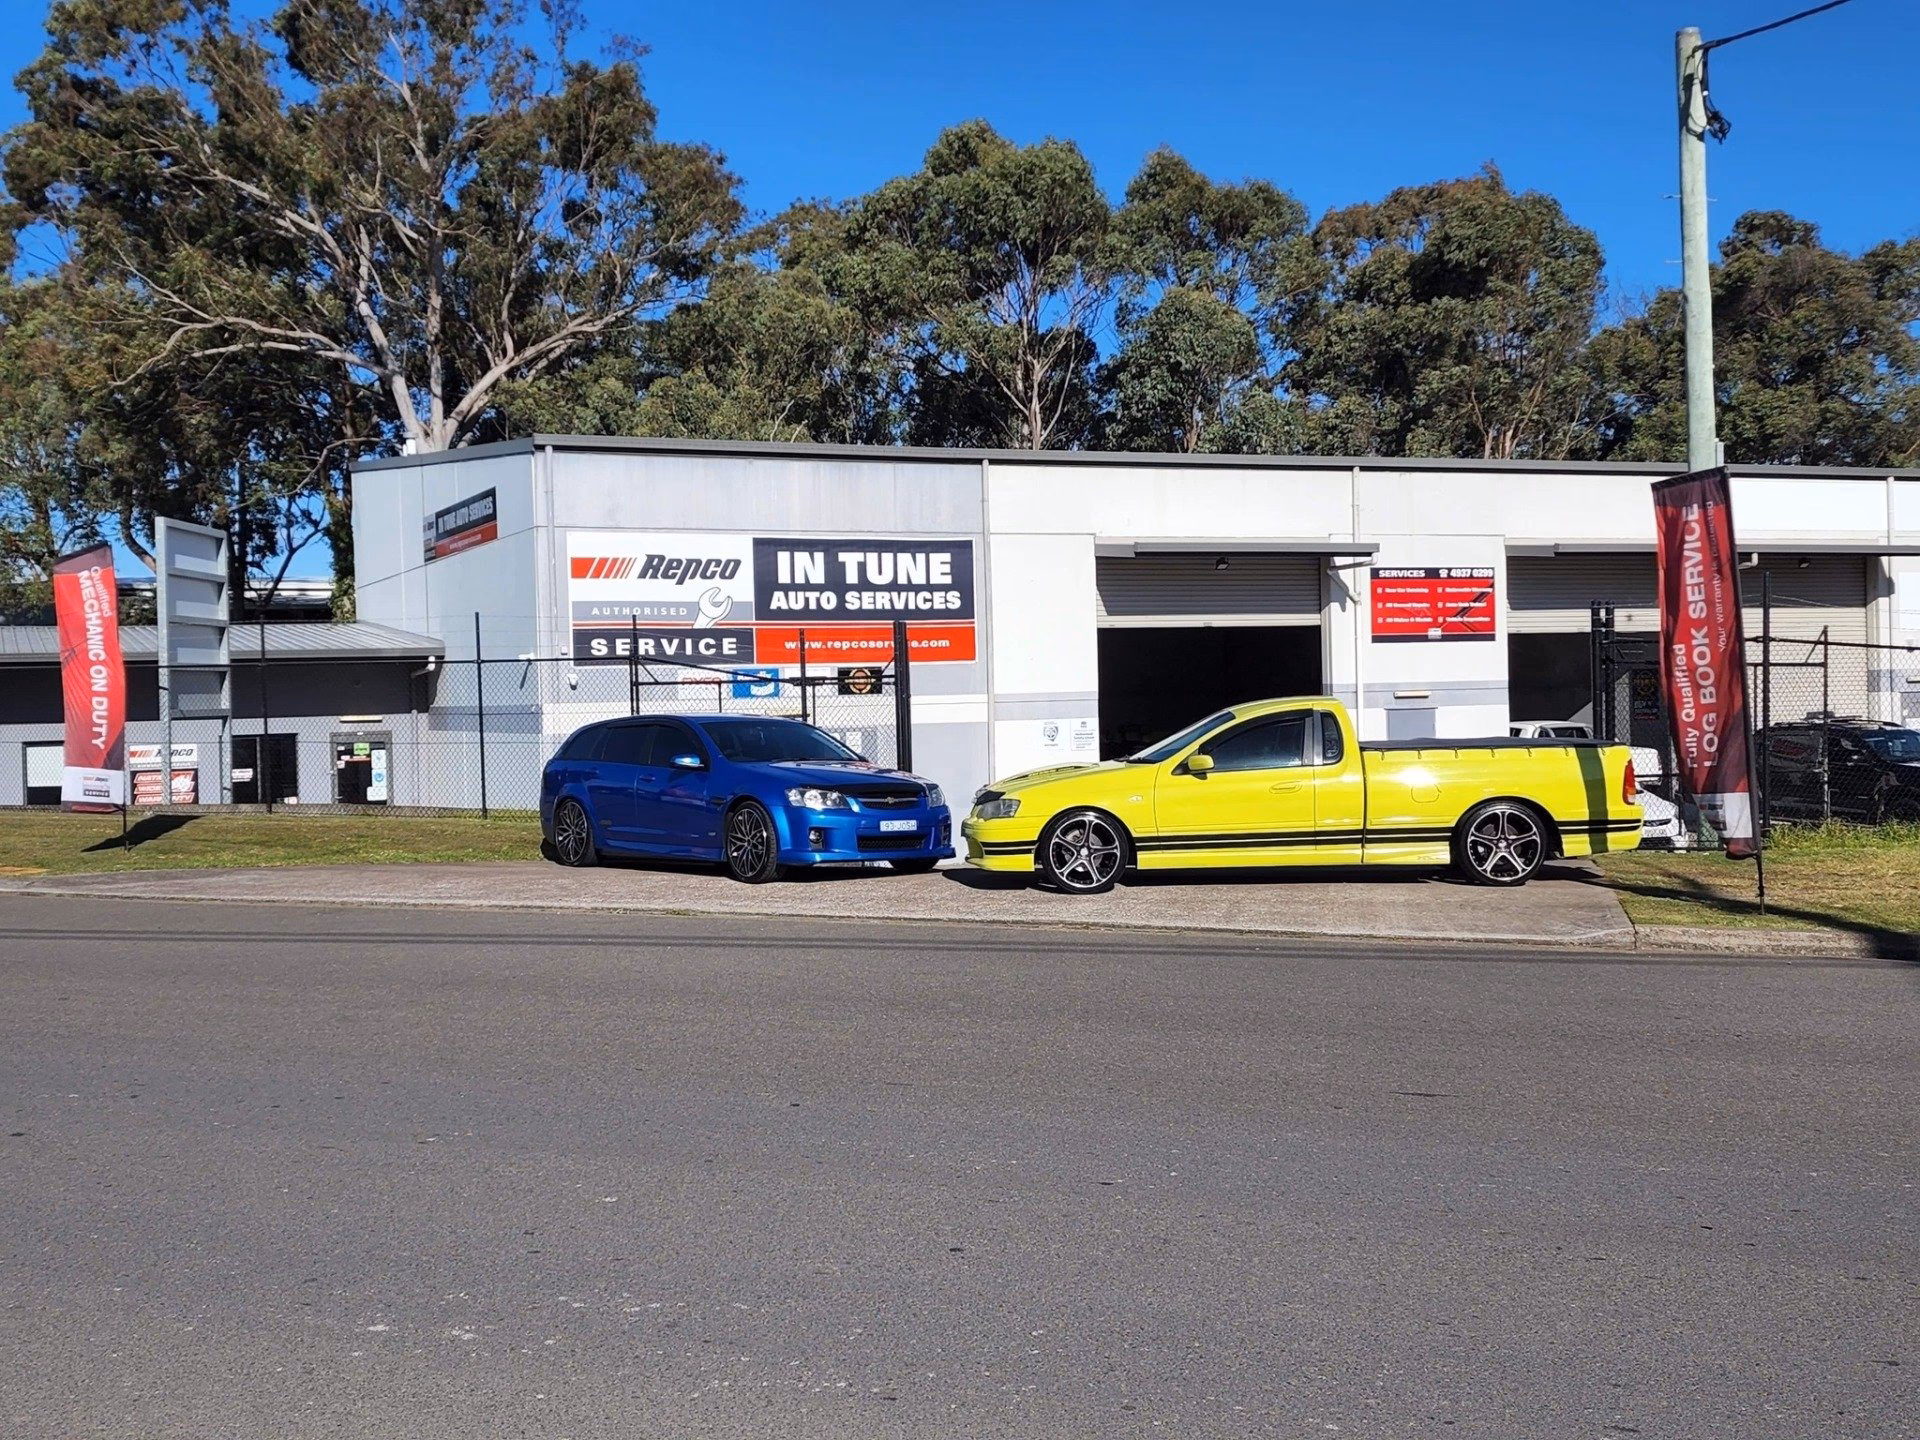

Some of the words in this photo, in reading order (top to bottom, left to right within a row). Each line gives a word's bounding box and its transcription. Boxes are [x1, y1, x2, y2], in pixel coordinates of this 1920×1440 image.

[637, 554, 742, 585] Repco
[777, 551, 825, 584] IN
[838, 552, 952, 585] TUNE
[1450, 569, 1471, 578] 4937
[1682, 503, 1708, 619] SERVICE
[91, 566, 112, 617] Qualified
[592, 606, 688, 616] AUTHORISED
[769, 591, 837, 610] AUTO
[845, 591, 961, 610] SERVICES
[1711, 573, 1725, 620] warranty
[78, 570, 106, 662] MECHANIC
[590, 637, 738, 656] SERVICE
[1716, 627, 1727, 652] Your
[89, 664, 108, 692] ON
[1673, 643, 1696, 723] Qualified
[1691, 625, 1718, 704] BOOK
[91, 696, 108, 750] DUTY
[1702, 712, 1719, 767] LOG
[1686, 728, 1700, 768] Fully
